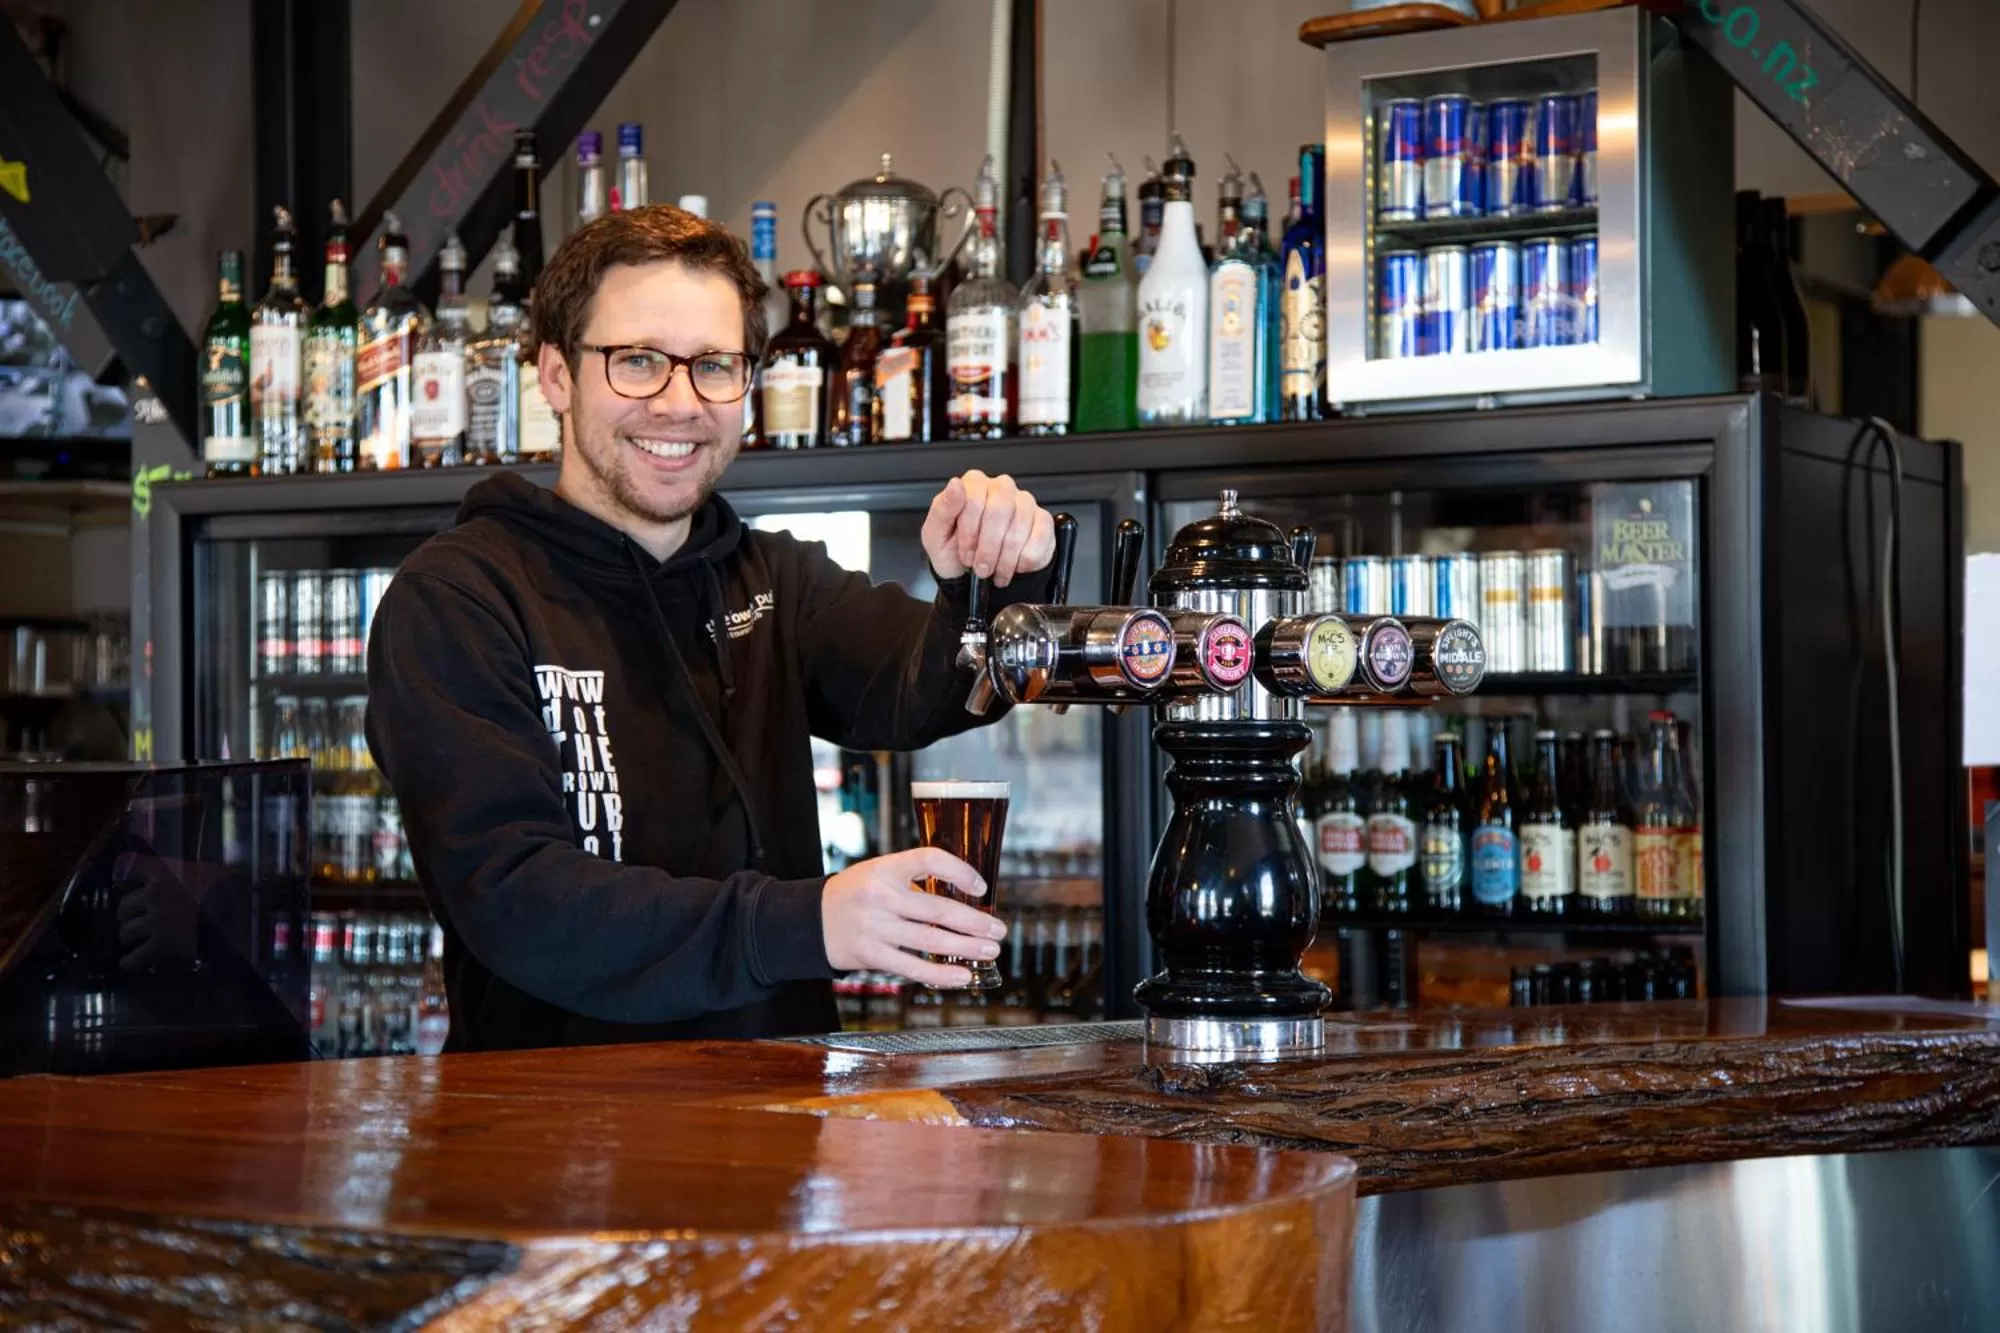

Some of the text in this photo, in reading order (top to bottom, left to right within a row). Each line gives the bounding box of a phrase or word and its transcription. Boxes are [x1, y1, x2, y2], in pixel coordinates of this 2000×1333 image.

[430, 103, 520, 218] drink
[0, 215, 79, 332] acebook
[1612, 519, 1671, 541] BEER
[1601, 541, 1685, 563] MASTER
[562, 771, 620, 793] ROWN
